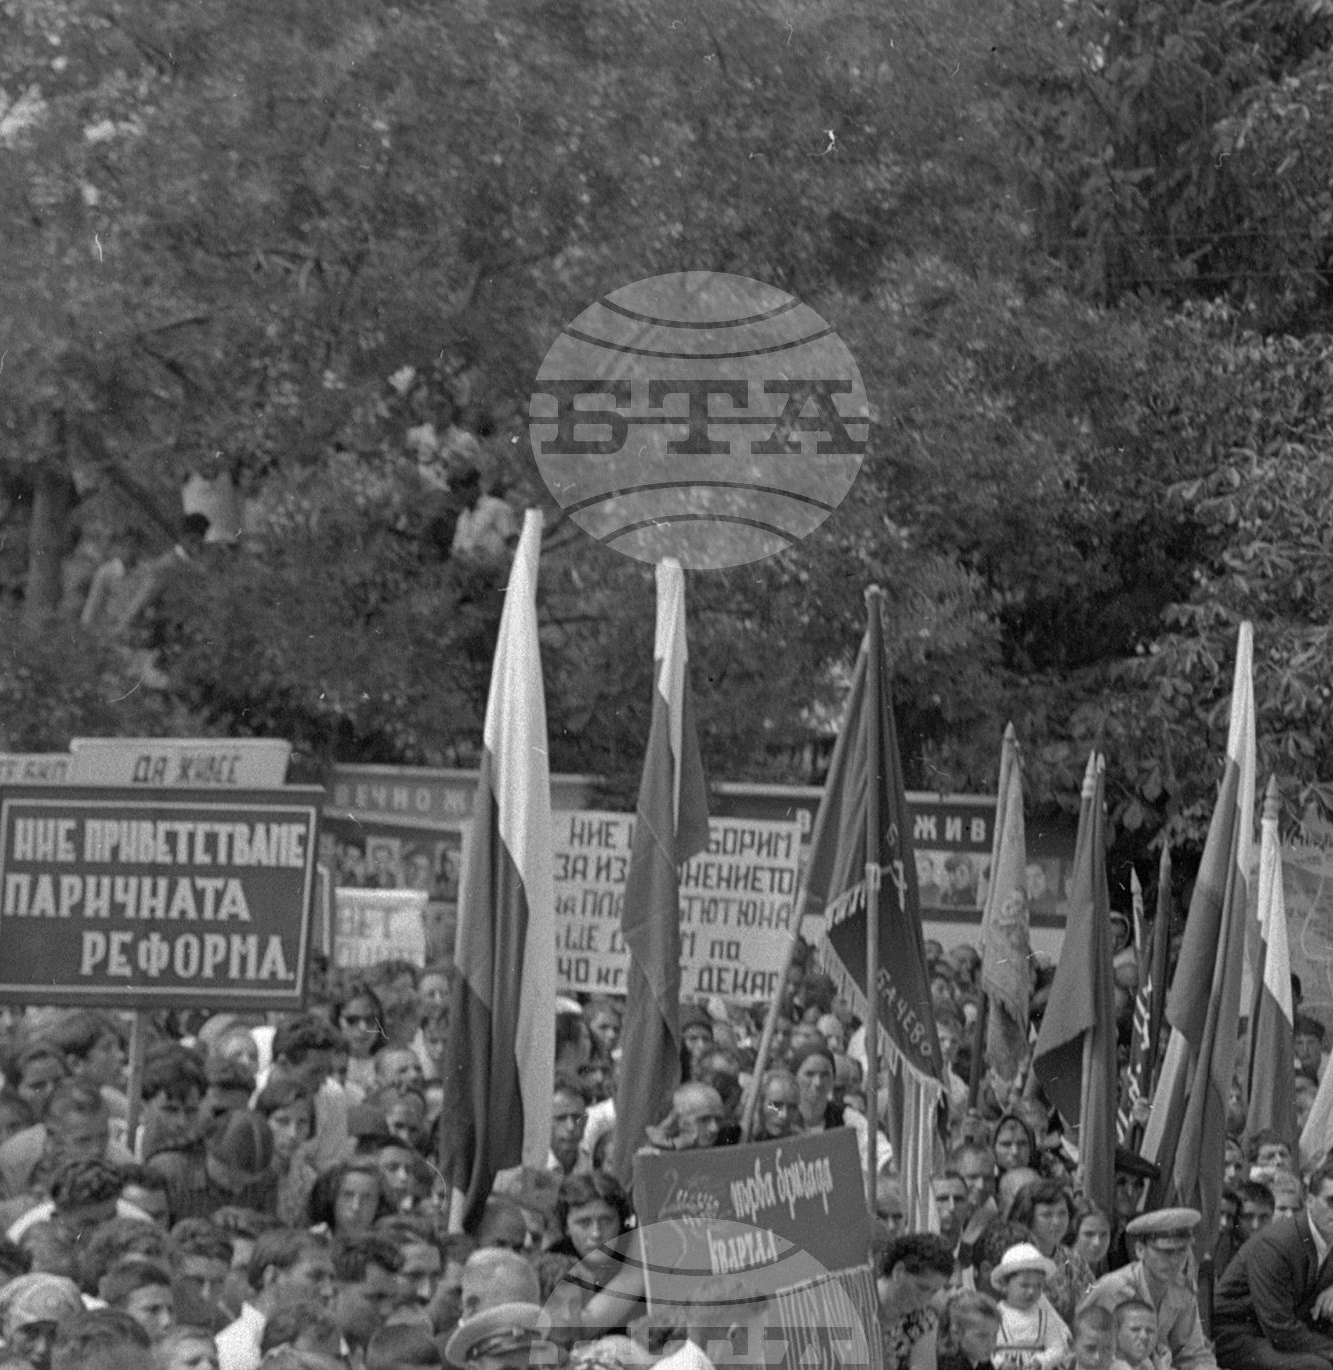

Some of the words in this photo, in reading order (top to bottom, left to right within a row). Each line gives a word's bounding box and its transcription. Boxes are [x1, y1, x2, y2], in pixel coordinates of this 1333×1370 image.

[13, 817, 78, 863] НИЕ
[570, 817, 620, 849] НИЕ
[4, 872, 252, 922] ПАРИЧНАТА
[80, 930, 296, 981] РЕФОРМА.
